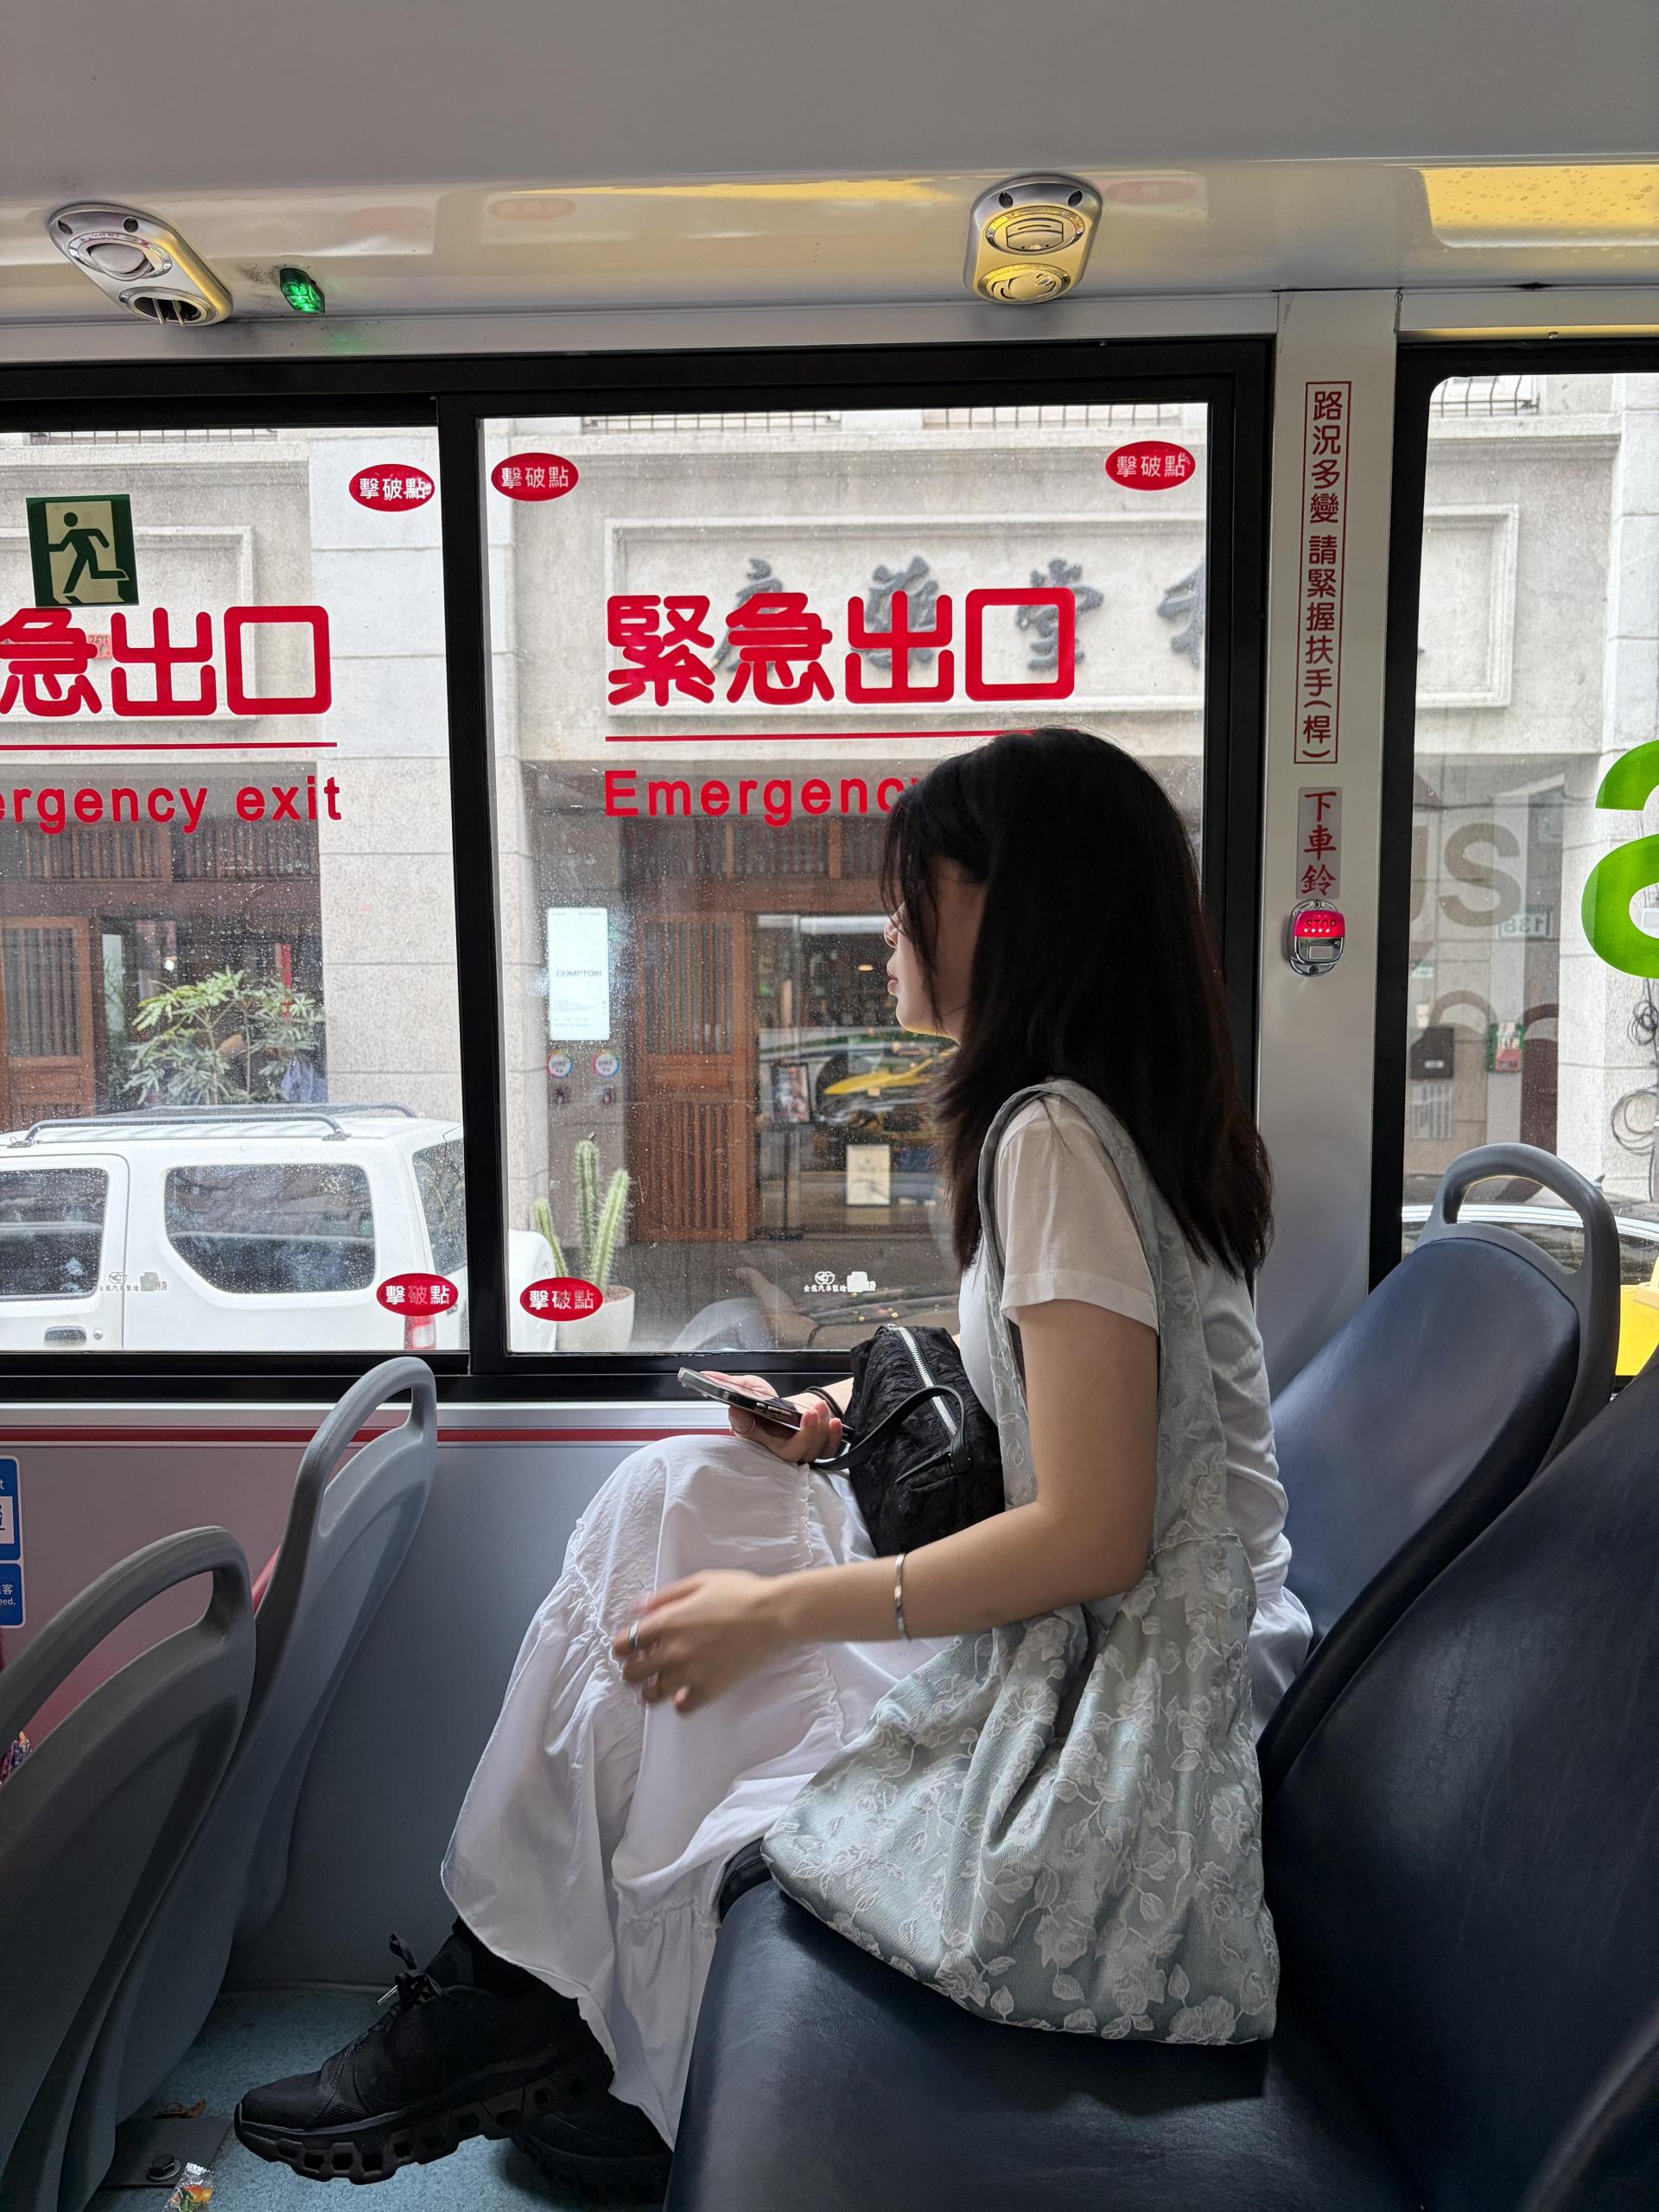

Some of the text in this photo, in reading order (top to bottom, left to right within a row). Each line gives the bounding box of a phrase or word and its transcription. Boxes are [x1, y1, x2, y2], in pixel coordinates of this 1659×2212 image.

[501, 467, 569, 489] 擊破點
[1116, 455, 1185, 477] 擊破點
[1310, 391, 1343, 524] 路況多變
[359, 477, 426, 500] 擊破點
[0, 605, 332, 717] 急出口
[607, 587, 1076, 707] 緊急出口
[0, 776, 342, 836] rgency exit
[603, 770, 918, 830] Emergenc
[1301, 791, 1338, 895] 下車鈴
[1306, 918, 1337, 928] STOP
[385, 1285, 450, 1306] 擊破點
[529, 1290, 594, 1311] 擊破點
